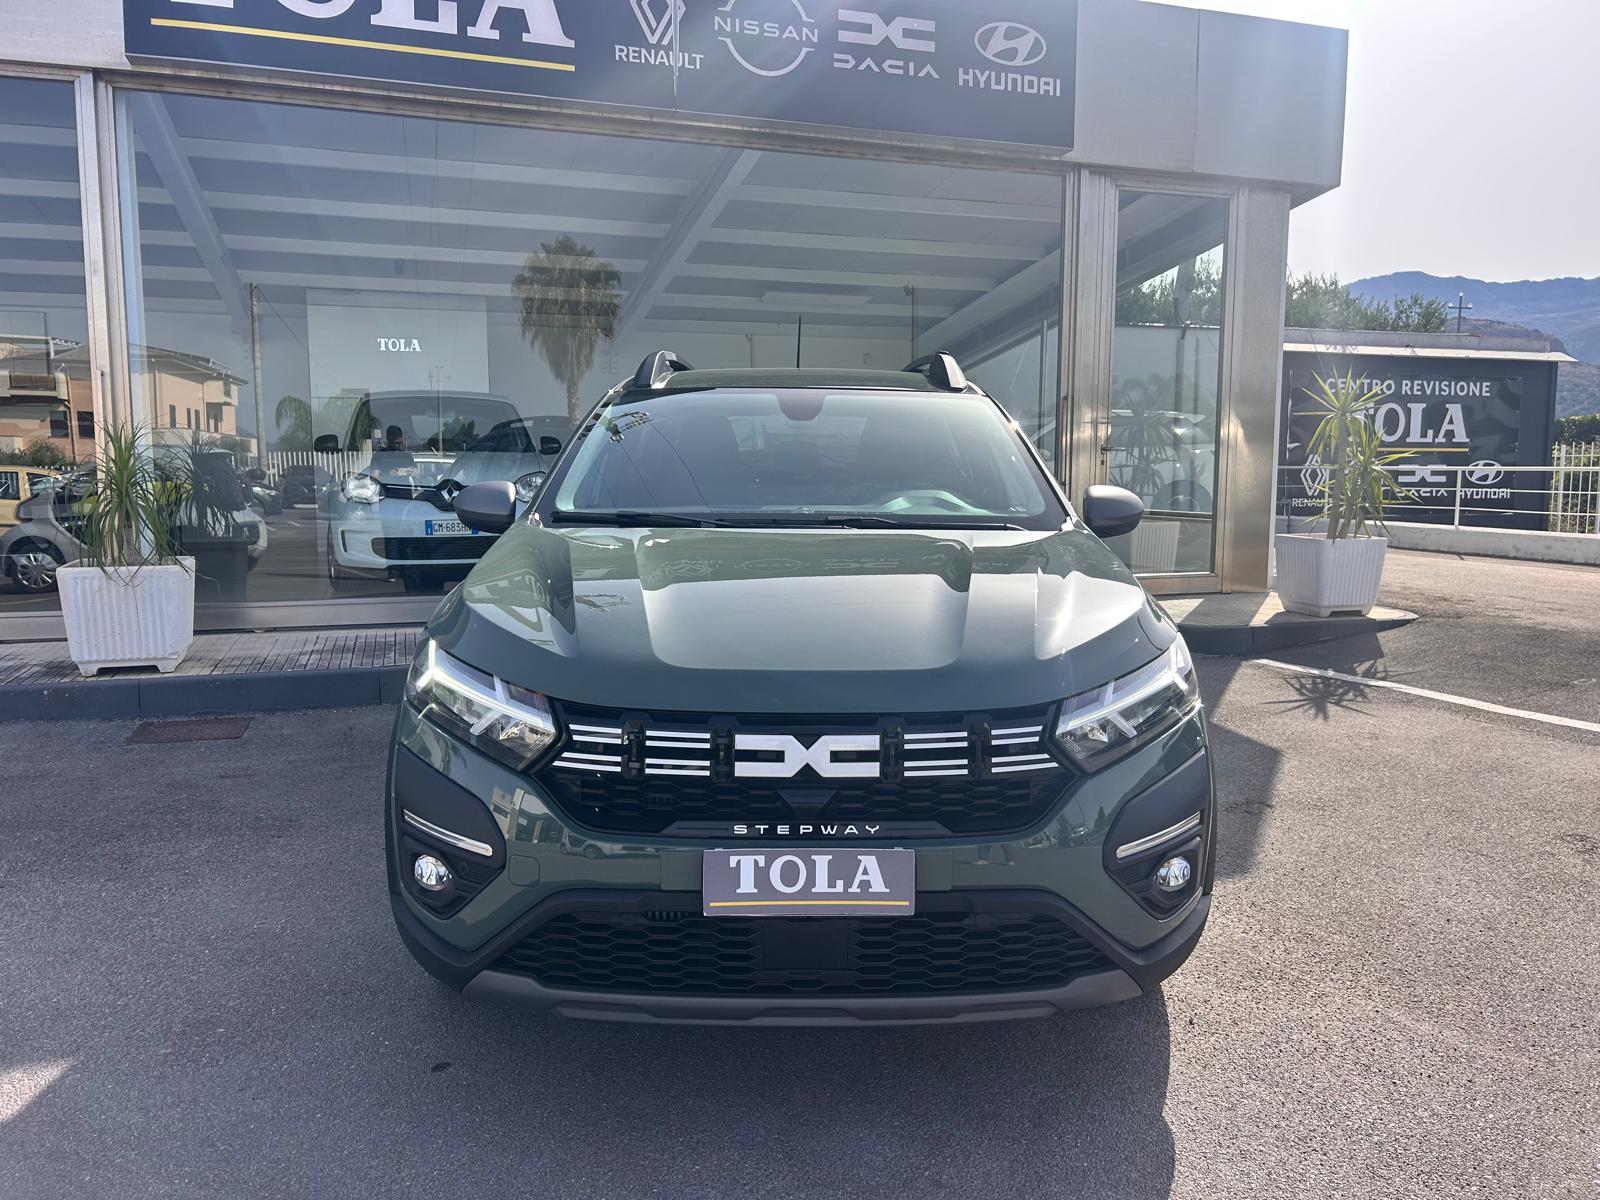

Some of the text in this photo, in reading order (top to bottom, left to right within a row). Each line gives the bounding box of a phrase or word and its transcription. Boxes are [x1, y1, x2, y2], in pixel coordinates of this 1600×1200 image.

[714, 16, 818, 43] NISSAN
[614, 44, 704, 70] RENAULT
[833, 53, 940, 79] DACIA
[958, 68, 1061, 97] HYUNDAI
[377, 338, 421, 352] TOLA
[1402, 380, 1491, 396] REVISIONE
[1345, 402, 1469, 443] OLA
[733, 825, 880, 835] STEPWAY
[729, 854, 890, 894] TOLA
